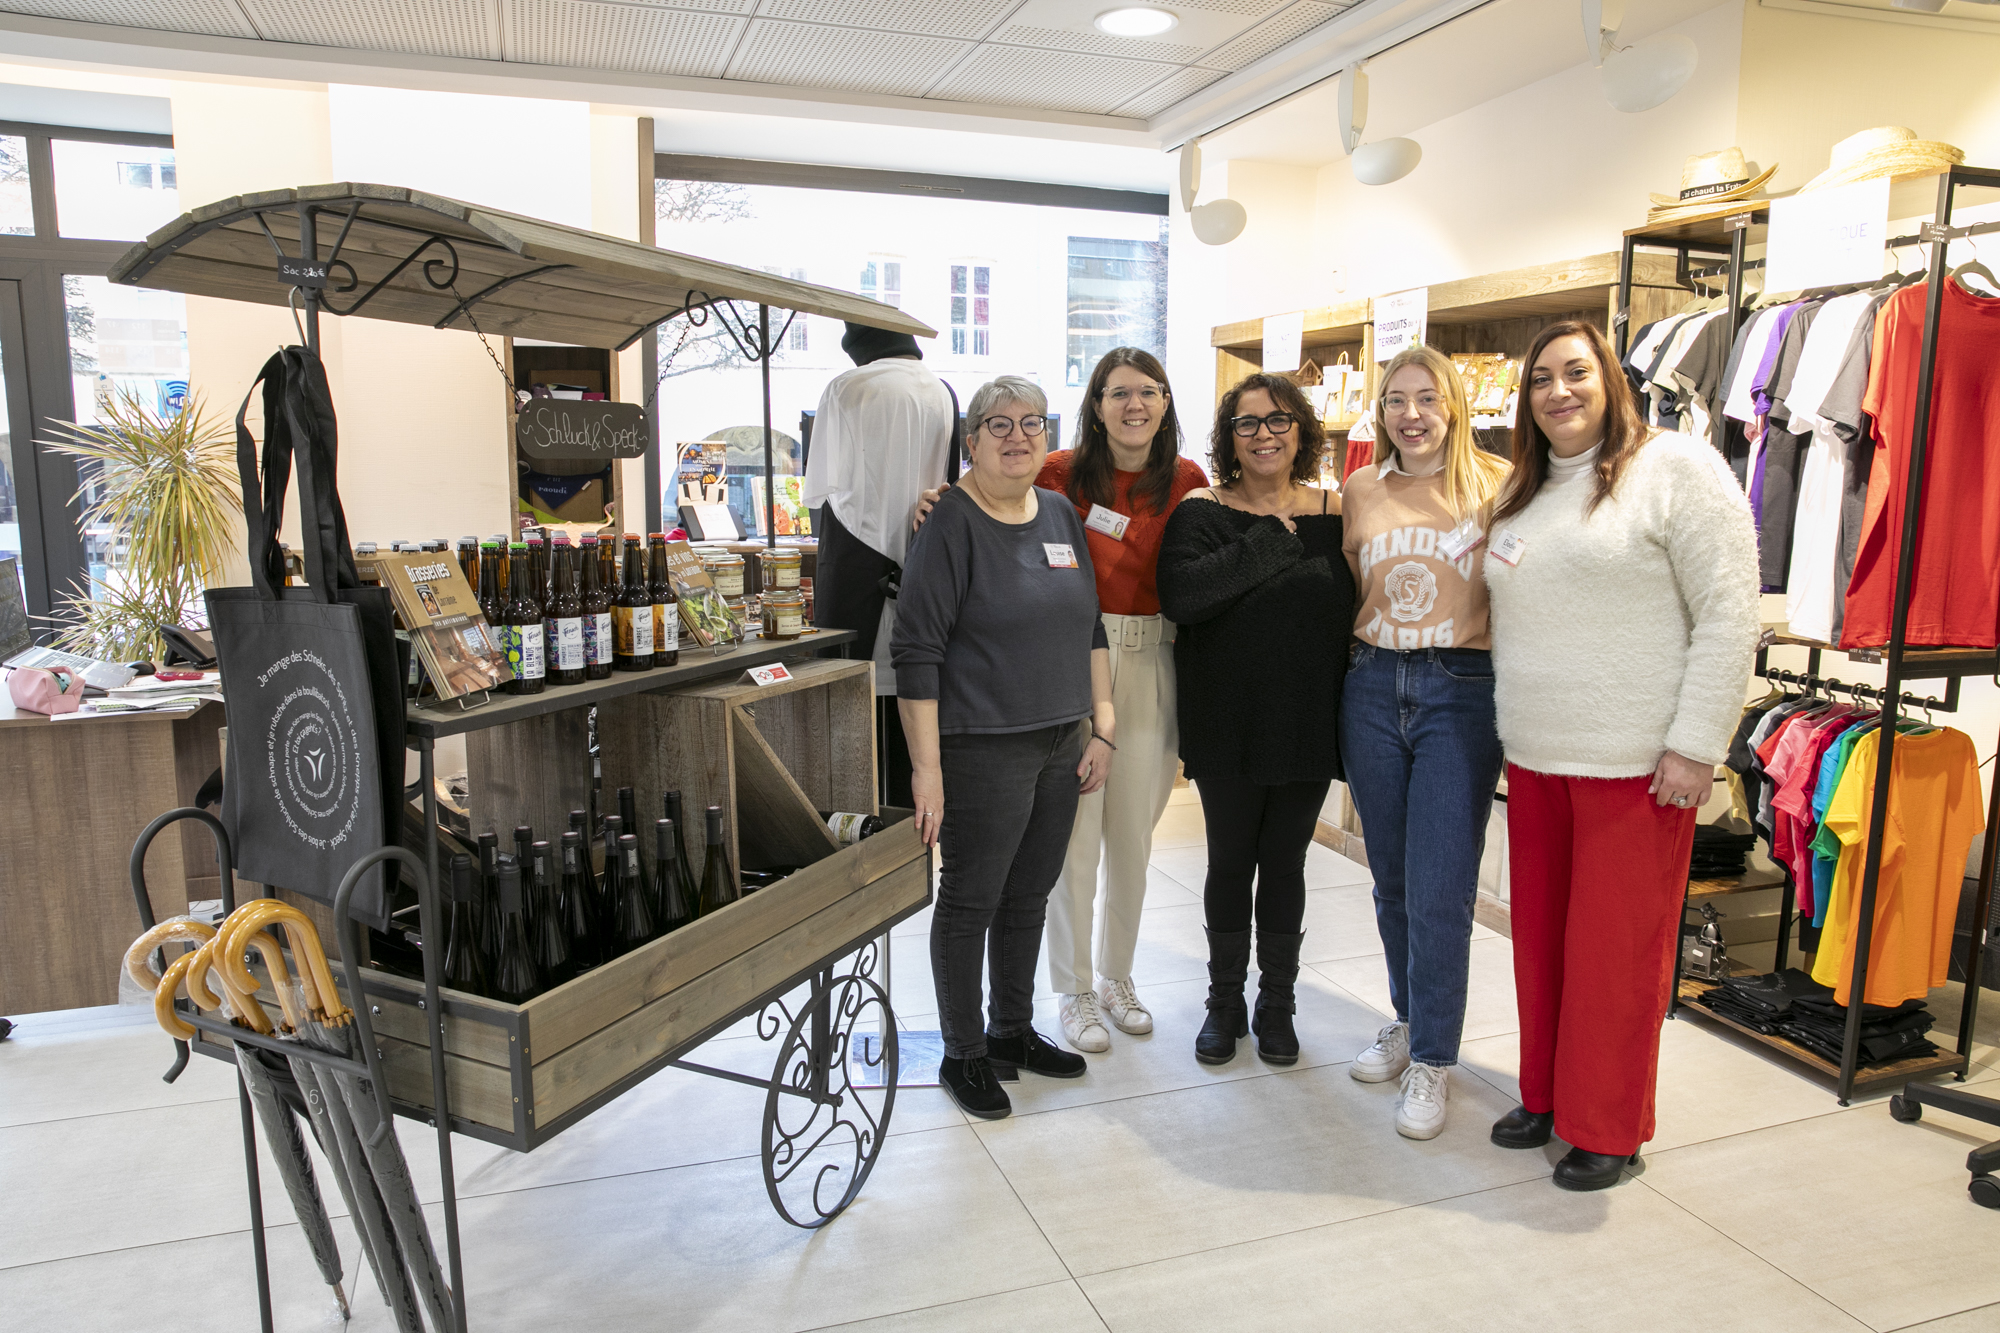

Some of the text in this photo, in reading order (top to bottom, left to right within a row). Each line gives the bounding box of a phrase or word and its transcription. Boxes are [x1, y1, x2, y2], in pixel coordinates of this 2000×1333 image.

[1691, 186, 1715, 196] chaud
[283, 264, 299, 276] Sac
[1378, 318, 1408, 332] PRODUITS
[1378, 334, 1403, 348] TERROIR
[534, 407, 641, 456] Schluck & Speck
[538, 485, 567, 494] raoudi
[1096, 514, 1111, 524] Julie
[680, 550, 695, 562] vins
[404, 561, 451, 583] Brasseries
[290, 650, 303, 663] des
[526, 646, 535, 668] BLONDE
[267, 656, 291, 678] mange
[257, 674, 269, 688] Je
[284, 691, 297, 705] dans
[296, 687, 302, 697] la
[270, 703, 286, 731] rutsche
[345, 715, 353, 727] et
[267, 731, 276, 741] je
[267, 740, 274, 750] et
[268, 751, 278, 787] schnaps
[274, 788, 281, 800] de
[279, 800, 299, 834] Schlucks
[298, 828, 307, 842] des
[307, 835, 319, 849] bois
[319, 839, 326, 850] Je
